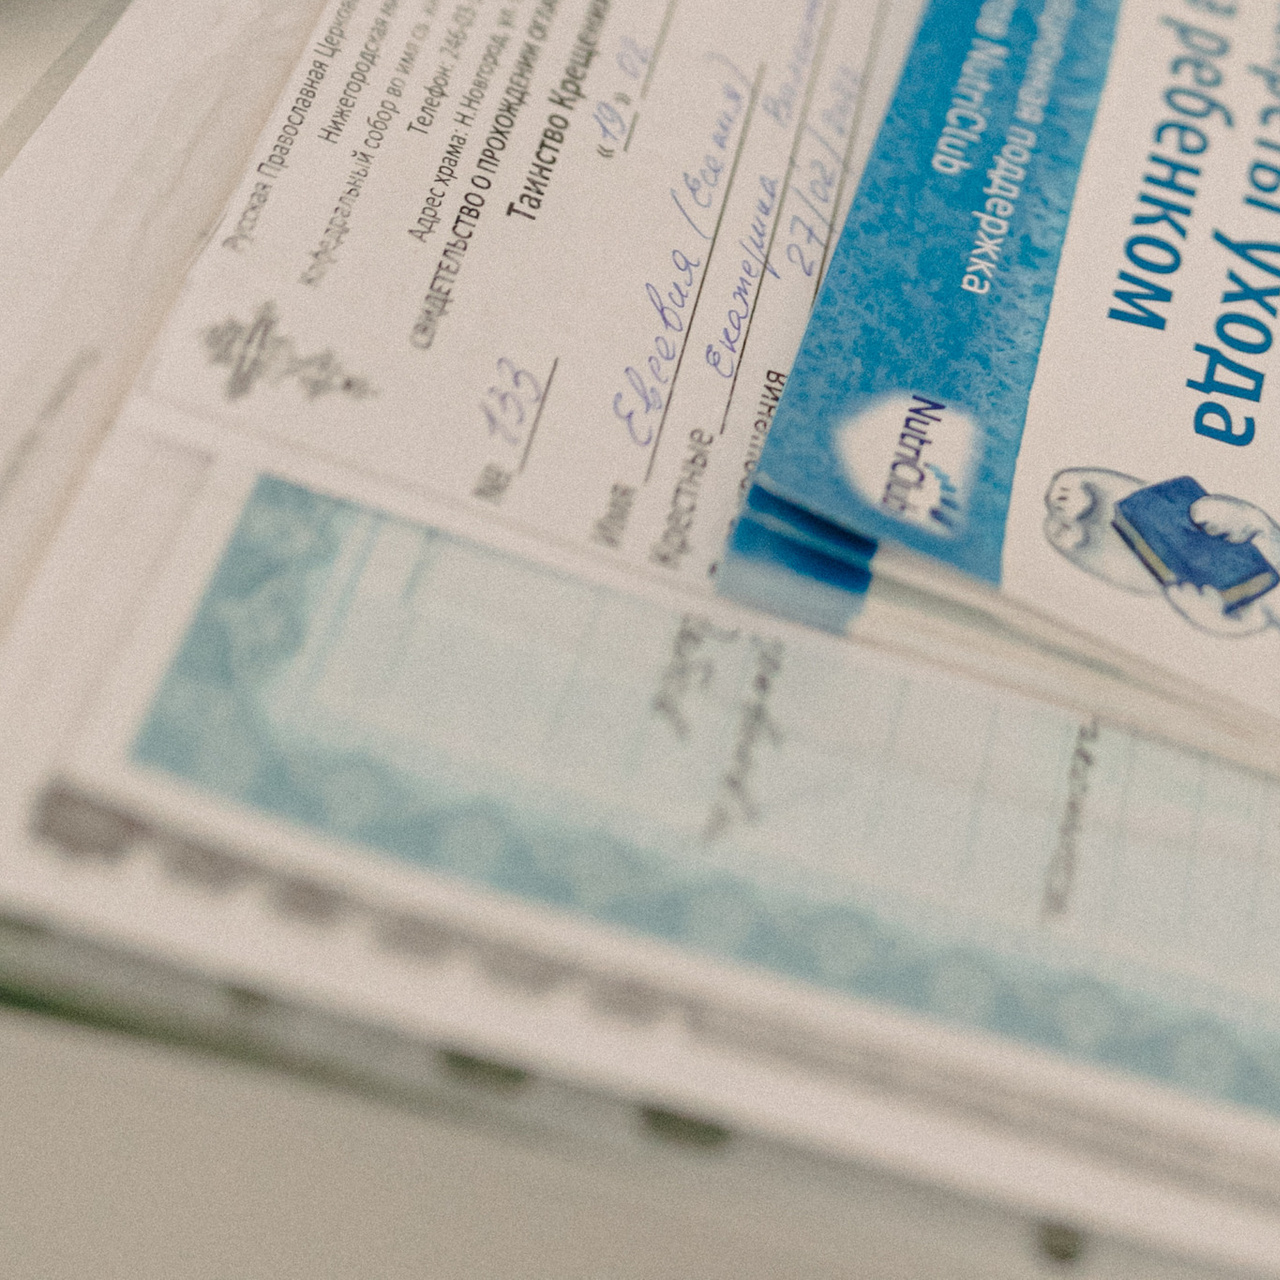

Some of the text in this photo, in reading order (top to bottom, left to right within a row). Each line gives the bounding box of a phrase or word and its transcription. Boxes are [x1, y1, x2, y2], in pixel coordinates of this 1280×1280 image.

[318, 18, 388, 144] Нижегородская
[363, 99, 400, 150] собор
[384, 75, 406, 99] во
[406, 65, 450, 135] Телефон:
[476, 42, 539, 174] ПРОХОЖДЕНИИ
[932, 40, 1008, 175] NutriClub
[221, 181, 272, 253] Русская
[256, 59, 329, 178] Православная
[407, 187, 446, 243] Адрес
[434, 134, 467, 186] храма:
[470, 174, 492, 191] О
[505, 113, 570, 221] Таинство
[962, 125, 1036, 296] поддержка
[1107, 19, 1234, 331] ребенком
[409, 191, 486, 352] СВИДЕТЕЛЬСТВО
[592, 483, 636, 549] Имя
[649, 428, 715, 570] Крестные
[875, 392, 954, 521] NutriClub
